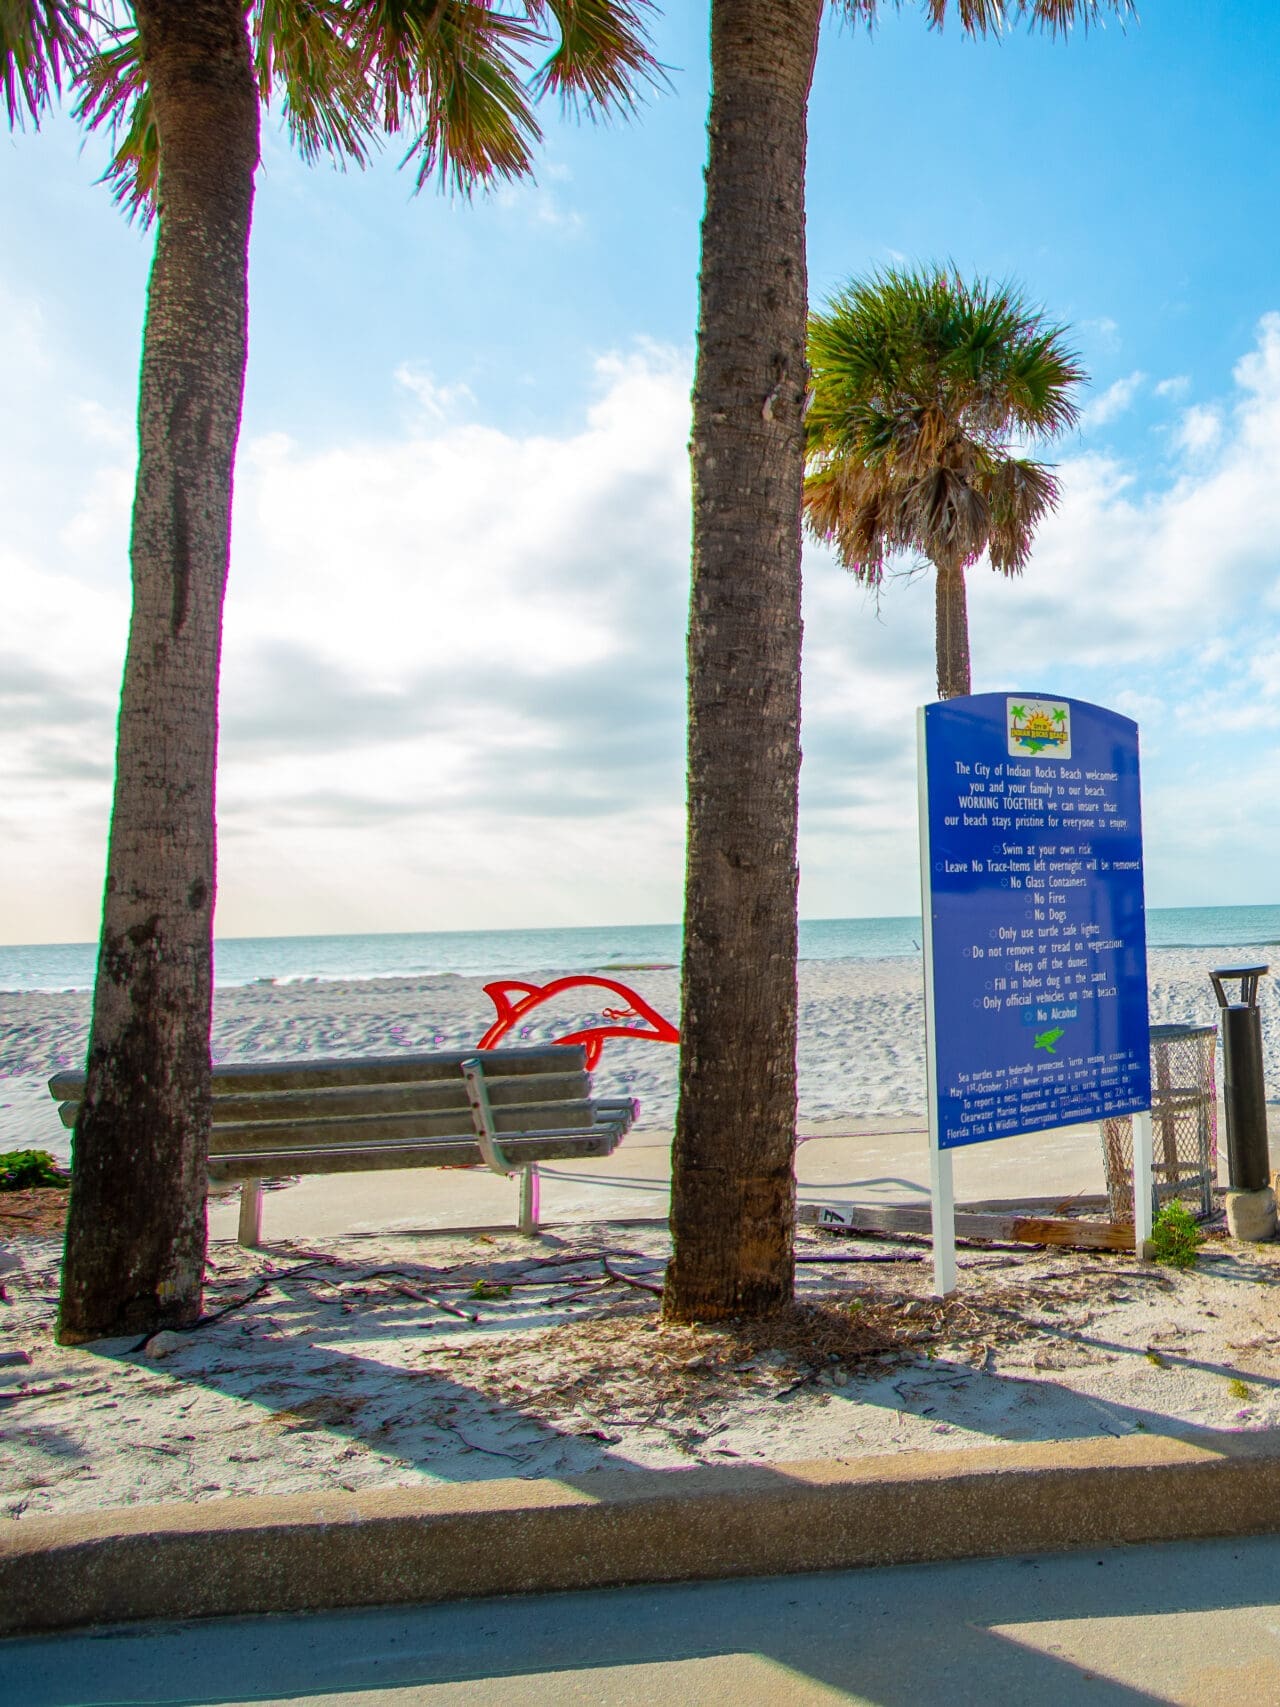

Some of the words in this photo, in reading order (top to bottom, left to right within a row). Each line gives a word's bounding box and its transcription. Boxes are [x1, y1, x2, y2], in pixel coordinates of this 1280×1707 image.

[955, 761, 970, 774] The
[974, 762, 990, 779] City
[995, 764, 1002, 776] of
[1006, 764, 1030, 777] Indian
[1035, 766, 1056, 778] Rocks
[1061, 767, 1082, 780] Beach
[1086, 769, 1118, 782] welcomes
[970, 782, 984, 796] you
[989, 780, 1004, 793] and
[1008, 784, 1026, 797] your
[1030, 782, 1053, 798] family
[1057, 785, 1064, 795] to
[1068, 786, 1080, 796] our
[958, 796, 999, 810] WORKING
[1004, 797, 1044, 810] TOGETHER
[1047, 802, 1058, 810] we
[1062, 802, 1074, 811] can
[1078, 800, 1100, 812] insure
[1104, 801, 1117, 812] that
[944, 816, 958, 826] our
[964, 814, 987, 826] beach
[992, 815, 1011, 830] stays
[1016, 815, 1044, 830] pristine
[1048, 815, 1058, 827] for
[1062, 817, 1094, 830] everyone
[1098, 817, 1106, 828] to
[1002, 843, 1022, 855] Swim
[1027, 845, 1035, 854] at
[1040, 846, 1056, 858] your
[1060, 846, 1074, 854] own
[945, 860, 968, 872] Leave
[972, 860, 983, 872] No
[986, 860, 1030, 872] Trace-Items
[1034, 860, 1046, 872] left
[1050, 860, 1082, 874] overnight
[1086, 859, 1097, 870] will
[1102, 860, 1109, 870] be
[1011, 876, 1022, 888] No
[1026, 876, 1044, 888] Glass
[1049, 876, 1086, 887] Containers
[1034, 893, 1044, 904] No
[1048, 892, 1066, 904] Fires
[1034, 910, 1045, 920] No
[1050, 909, 1066, 923] Dogs
[999, 927, 1016, 943] Only
[1022, 929, 1034, 938] use
[1038, 926, 1058, 937] turtle
[1063, 924, 1076, 936] safe
[1081, 922, 1100, 938] lights
[972, 946, 984, 958] Do
[988, 947, 1002, 957] not
[1006, 946, 1034, 956] remove
[1038, 944, 1046, 954] or
[1052, 940, 1070, 952] tread
[1075, 942, 1083, 951] on
[1088, 938, 1122, 954] vegetation
[1014, 960, 1032, 974] Keep
[1038, 958, 1048, 970] off
[1052, 956, 1062, 968] the
[1068, 956, 1088, 967] dunes
[994, 978, 1006, 990] Fill
[1010, 978, 1018, 988] in
[1022, 976, 1042, 988] holes
[1046, 974, 1060, 989] dug
[1064, 973, 1071, 984] in
[1076, 972, 1086, 983] the
[1091, 970, 1106, 982] sand
[984, 996, 1002, 1012] Only
[1006, 992, 1032, 1006] official
[1036, 990, 1064, 1003] vehicles
[1069, 991, 1078, 1000] on
[1082, 987, 1093, 998] the
[1098, 985, 1117, 997] beach
[1037, 1009, 1048, 1020] No
[1051, 1006, 1078, 1020] Alcohol
[958, 1072, 969, 1082] Sea
[973, 1070, 992, 1080] turtles
[996, 1069, 1005, 1078] are
[1008, 1064, 1034, 1076] federally
[950, 1088, 962, 1099] May
[964, 1099, 971, 1109] To
[974, 1096, 994, 1110] report
[996, 1096, 1000, 1104] a
[960, 1111, 994, 1123] Clearwater
[997, 1106, 1017, 1117] Marine
[1020, 1101, 1048, 1115] Aquarium
[946, 1126, 969, 1139] Florida
[972, 1124, 985, 1135] Fish
[988, 1122, 993, 1132] &
[995, 1118, 1018, 1130] Wildlife
